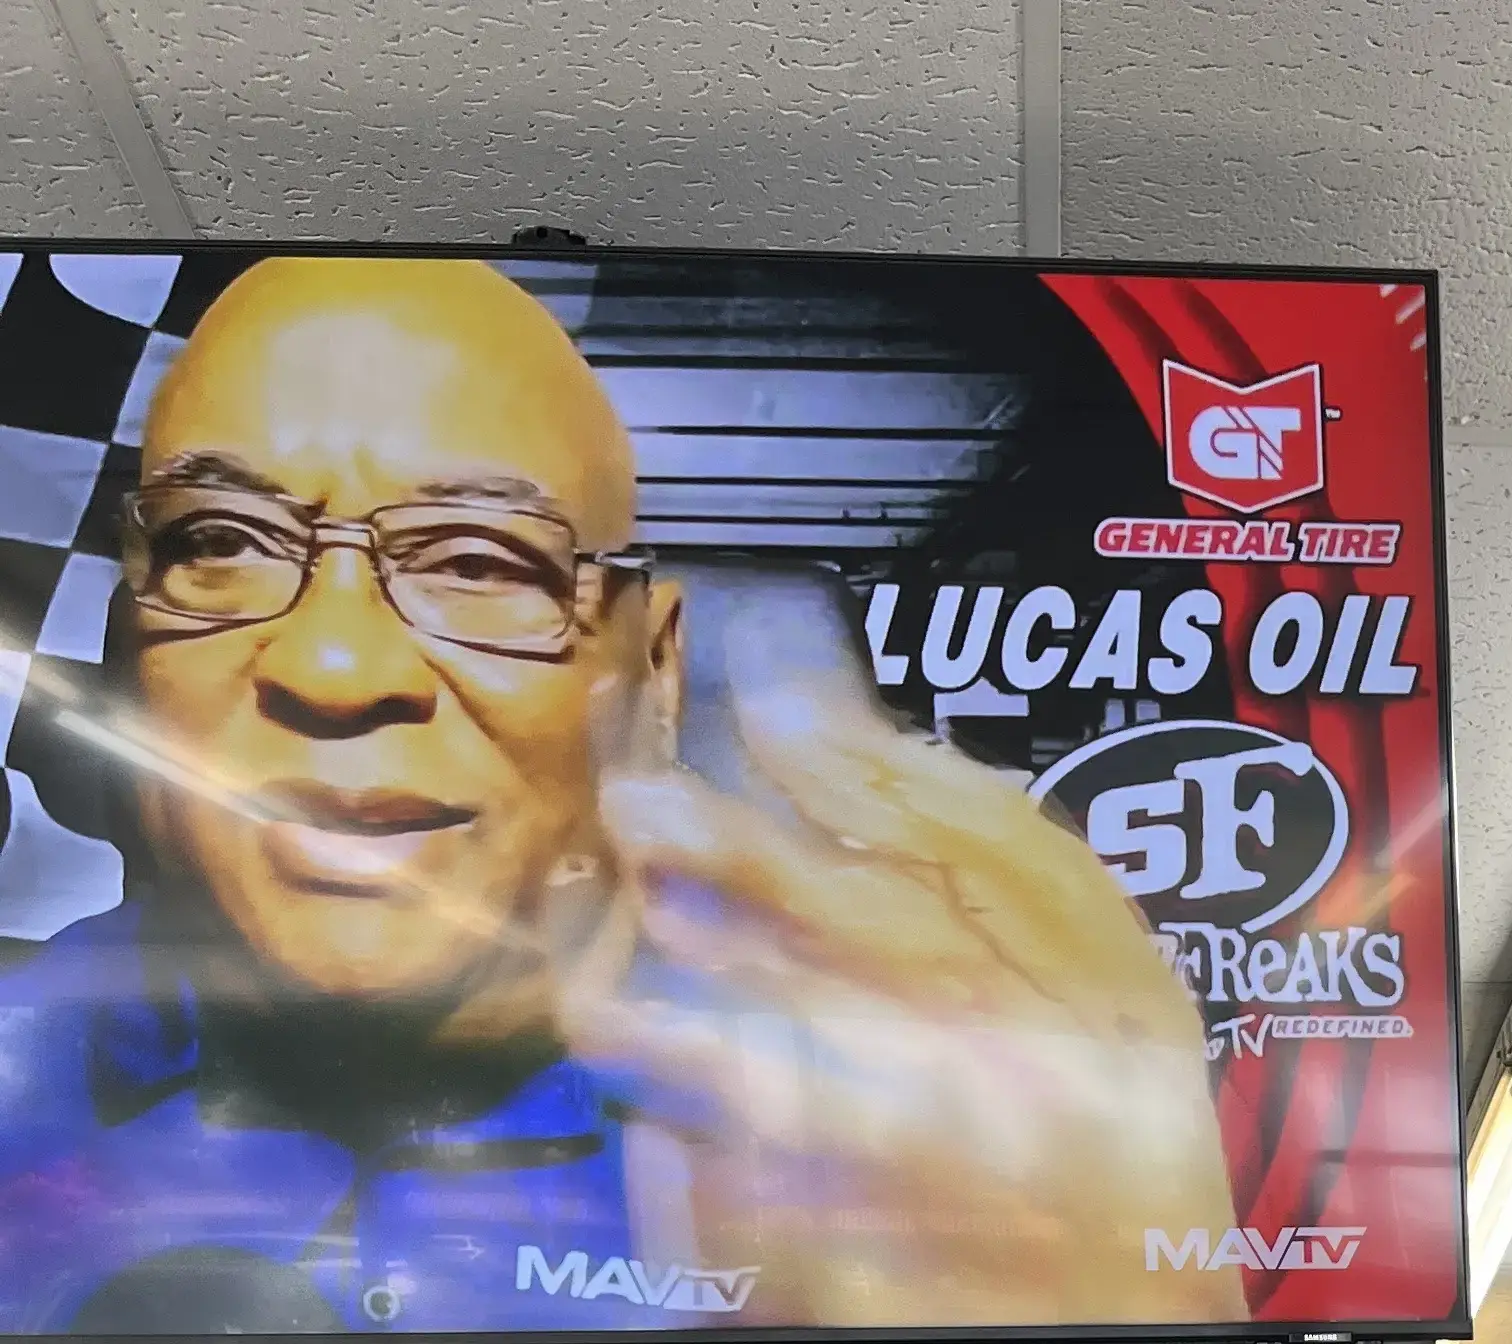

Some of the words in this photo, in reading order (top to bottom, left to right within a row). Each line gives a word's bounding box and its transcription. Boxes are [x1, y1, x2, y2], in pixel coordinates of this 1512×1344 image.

[1095, 518, 1291, 560] GENERAL
[1299, 522, 1400, 563] TIRE
[865, 584, 1222, 695] LUCAS
[1248, 592, 1418, 695] OIL
